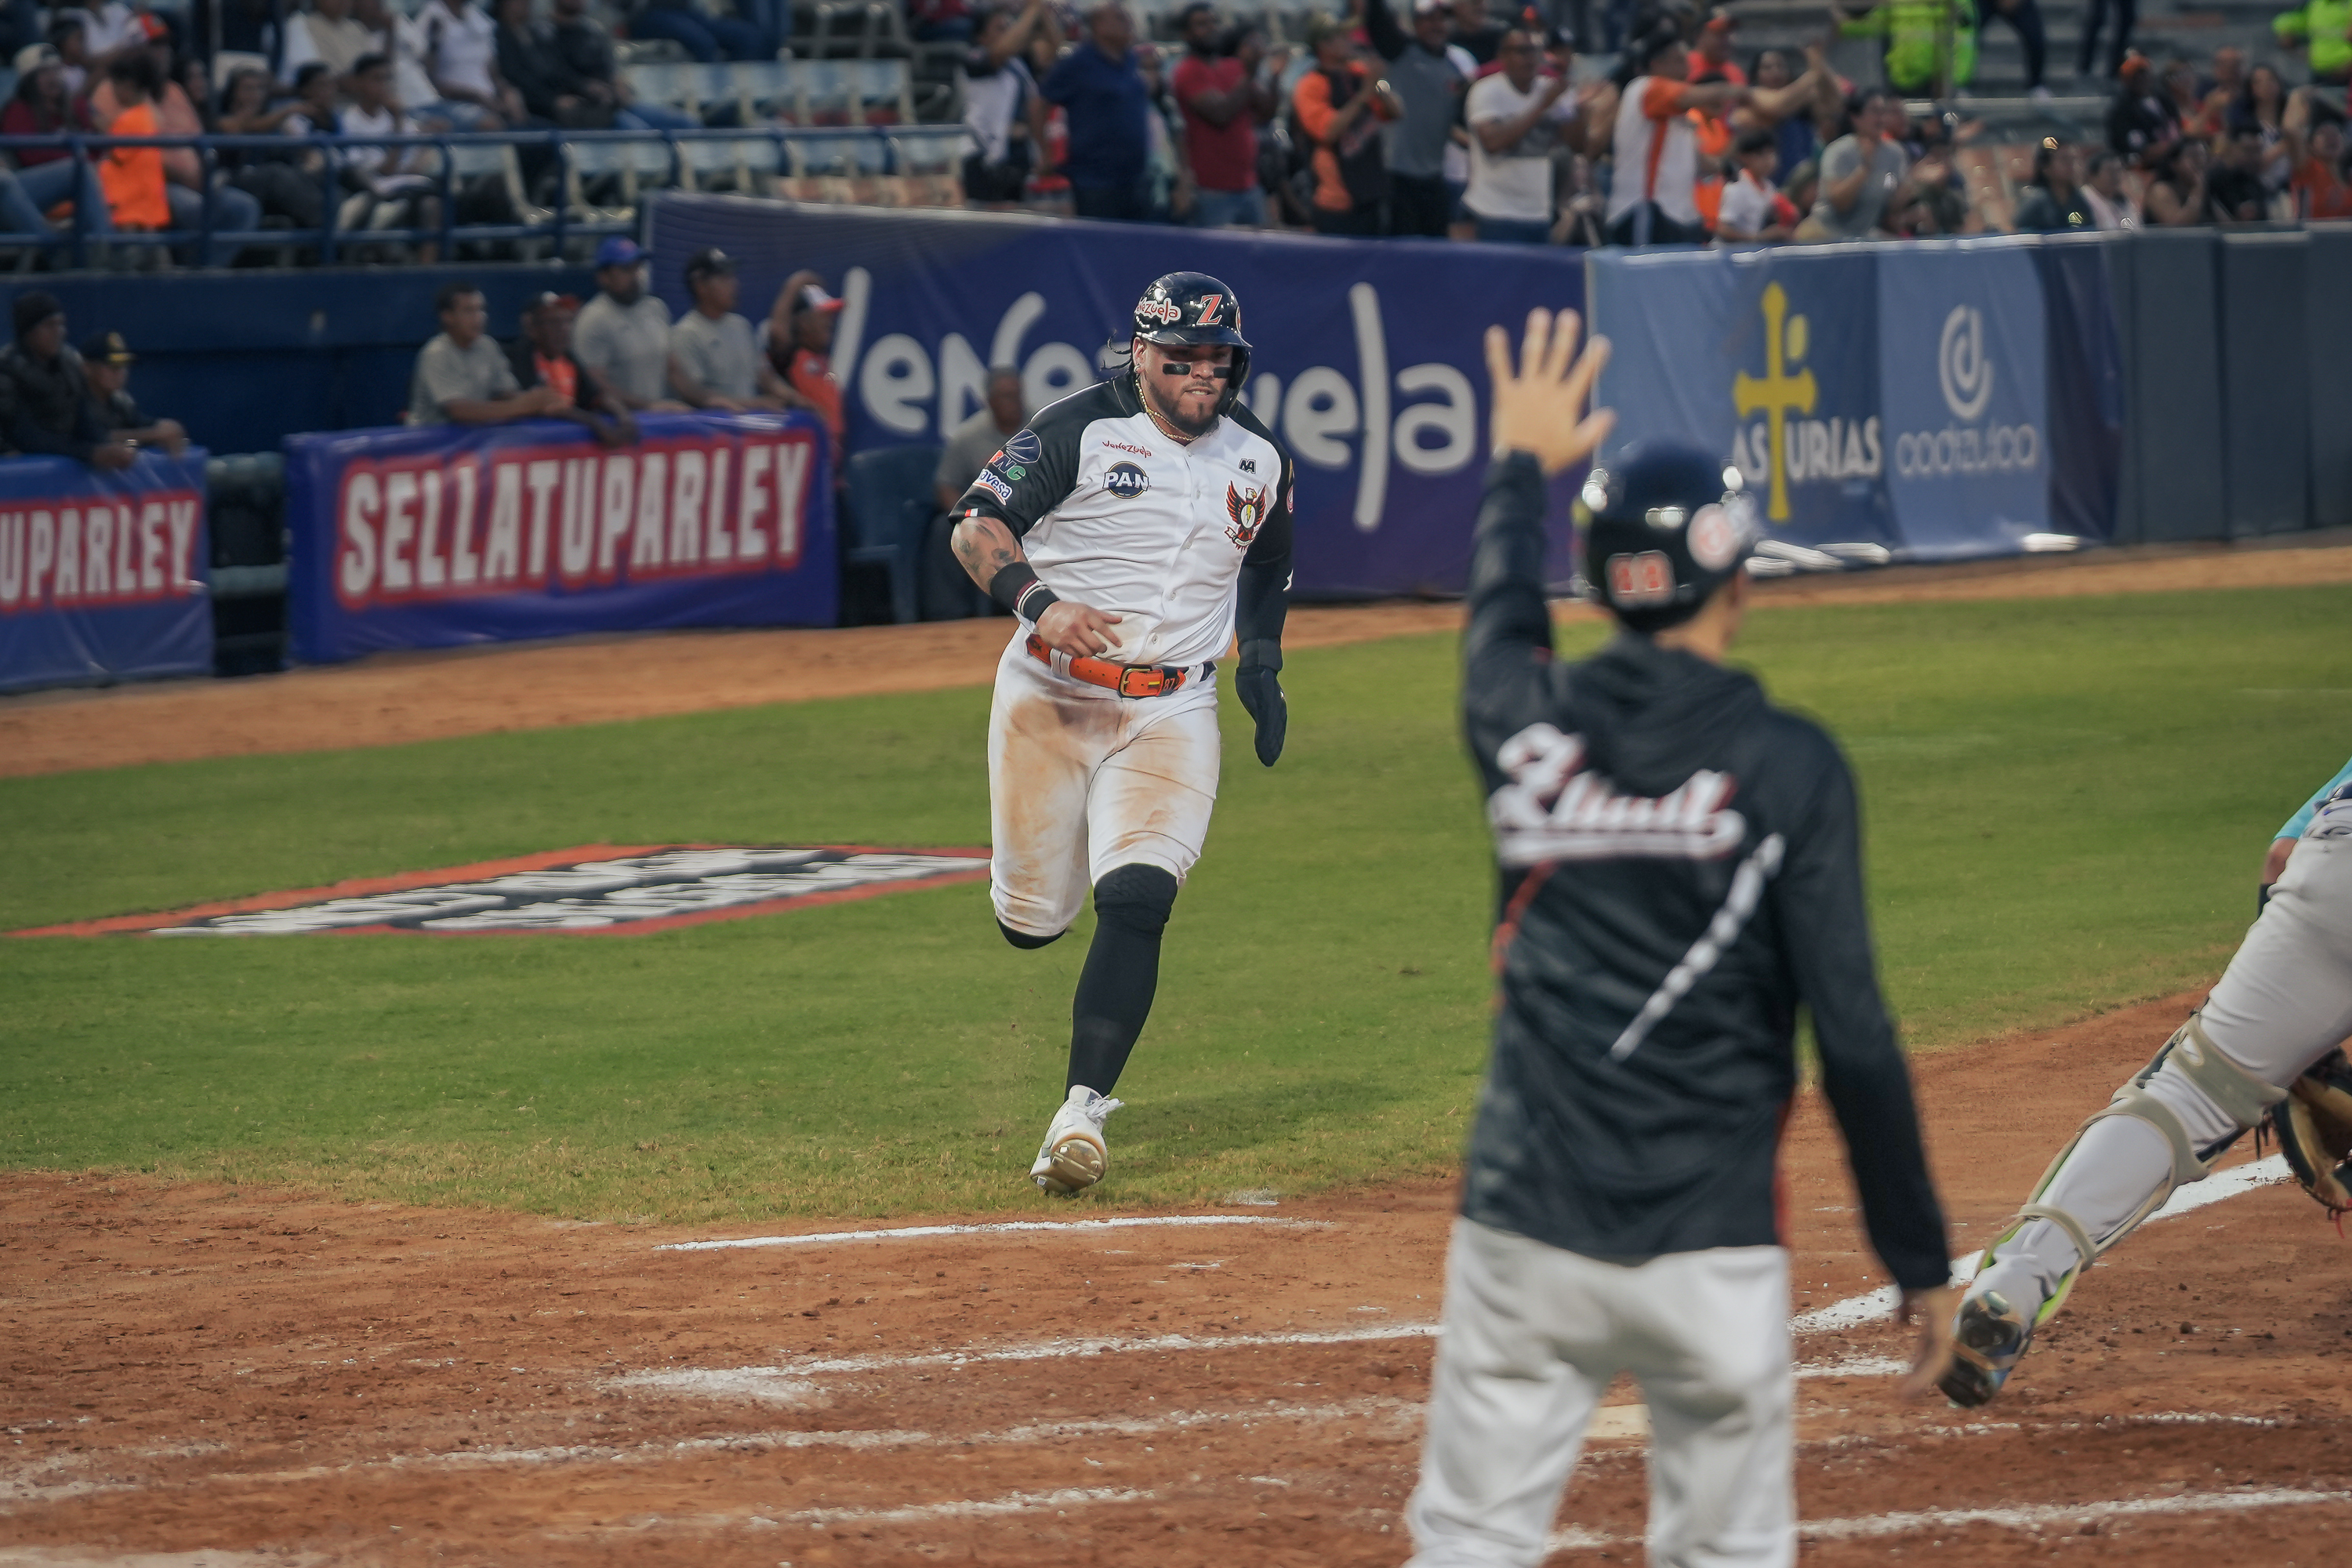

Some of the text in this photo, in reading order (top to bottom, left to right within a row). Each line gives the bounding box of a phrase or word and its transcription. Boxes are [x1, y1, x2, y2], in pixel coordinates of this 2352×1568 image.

[1196, 294, 1222, 325] Z
[339, 441, 811, 595] SELLATUPARLEY
[1163, 677, 1176, 691] 87
